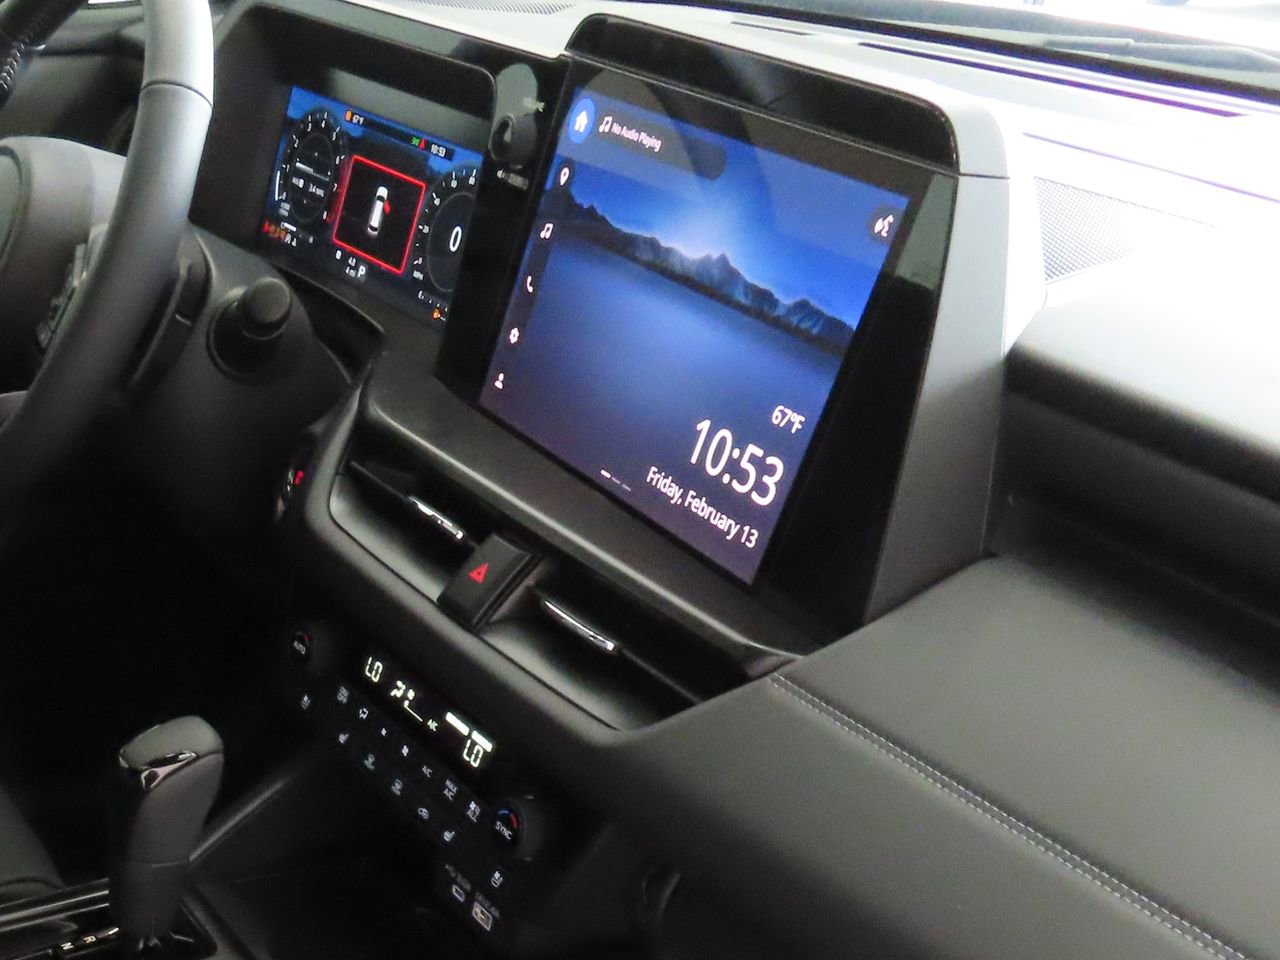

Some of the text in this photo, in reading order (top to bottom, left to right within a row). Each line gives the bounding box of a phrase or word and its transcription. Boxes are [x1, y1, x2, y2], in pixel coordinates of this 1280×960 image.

[611, 121, 662, 153] No Audio Playing
[449, 226, 462, 252] 0
[690, 418, 785, 506] 10:53
[646, 465, 759, 549] Friday, February 13
[495, 820, 513, 840] SYNC
[61, 942, 74, 951] N
[83, 935, 97, 944] R
